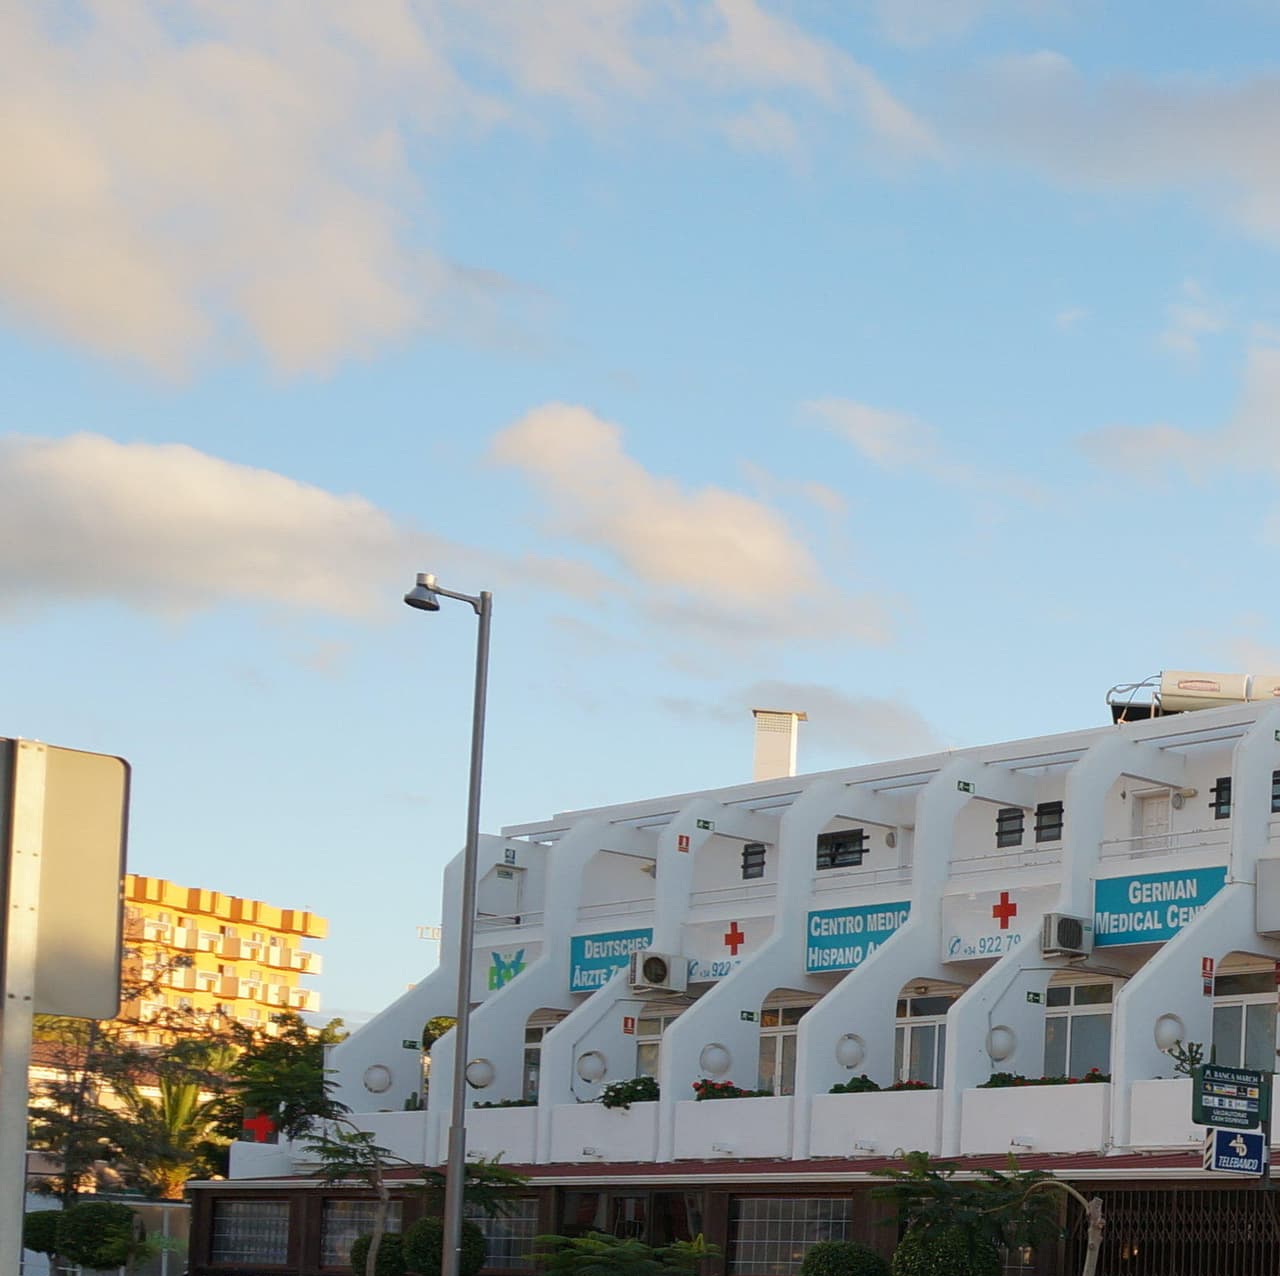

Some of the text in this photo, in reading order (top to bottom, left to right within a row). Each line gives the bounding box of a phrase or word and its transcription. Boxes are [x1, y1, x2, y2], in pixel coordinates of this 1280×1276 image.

[1128, 878, 1198, 905] GERMAN
[810, 910, 909, 937] CENTRO MEDIC
[1095, 904, 1205, 935] MEDICAL CEN
[584, 936, 649, 960] DEUTSCHES
[808, 945, 863, 967] HISPANO
[978, 935, 1002, 954] 922
[1218, 1156, 1259, 1170] TELEBANCO
